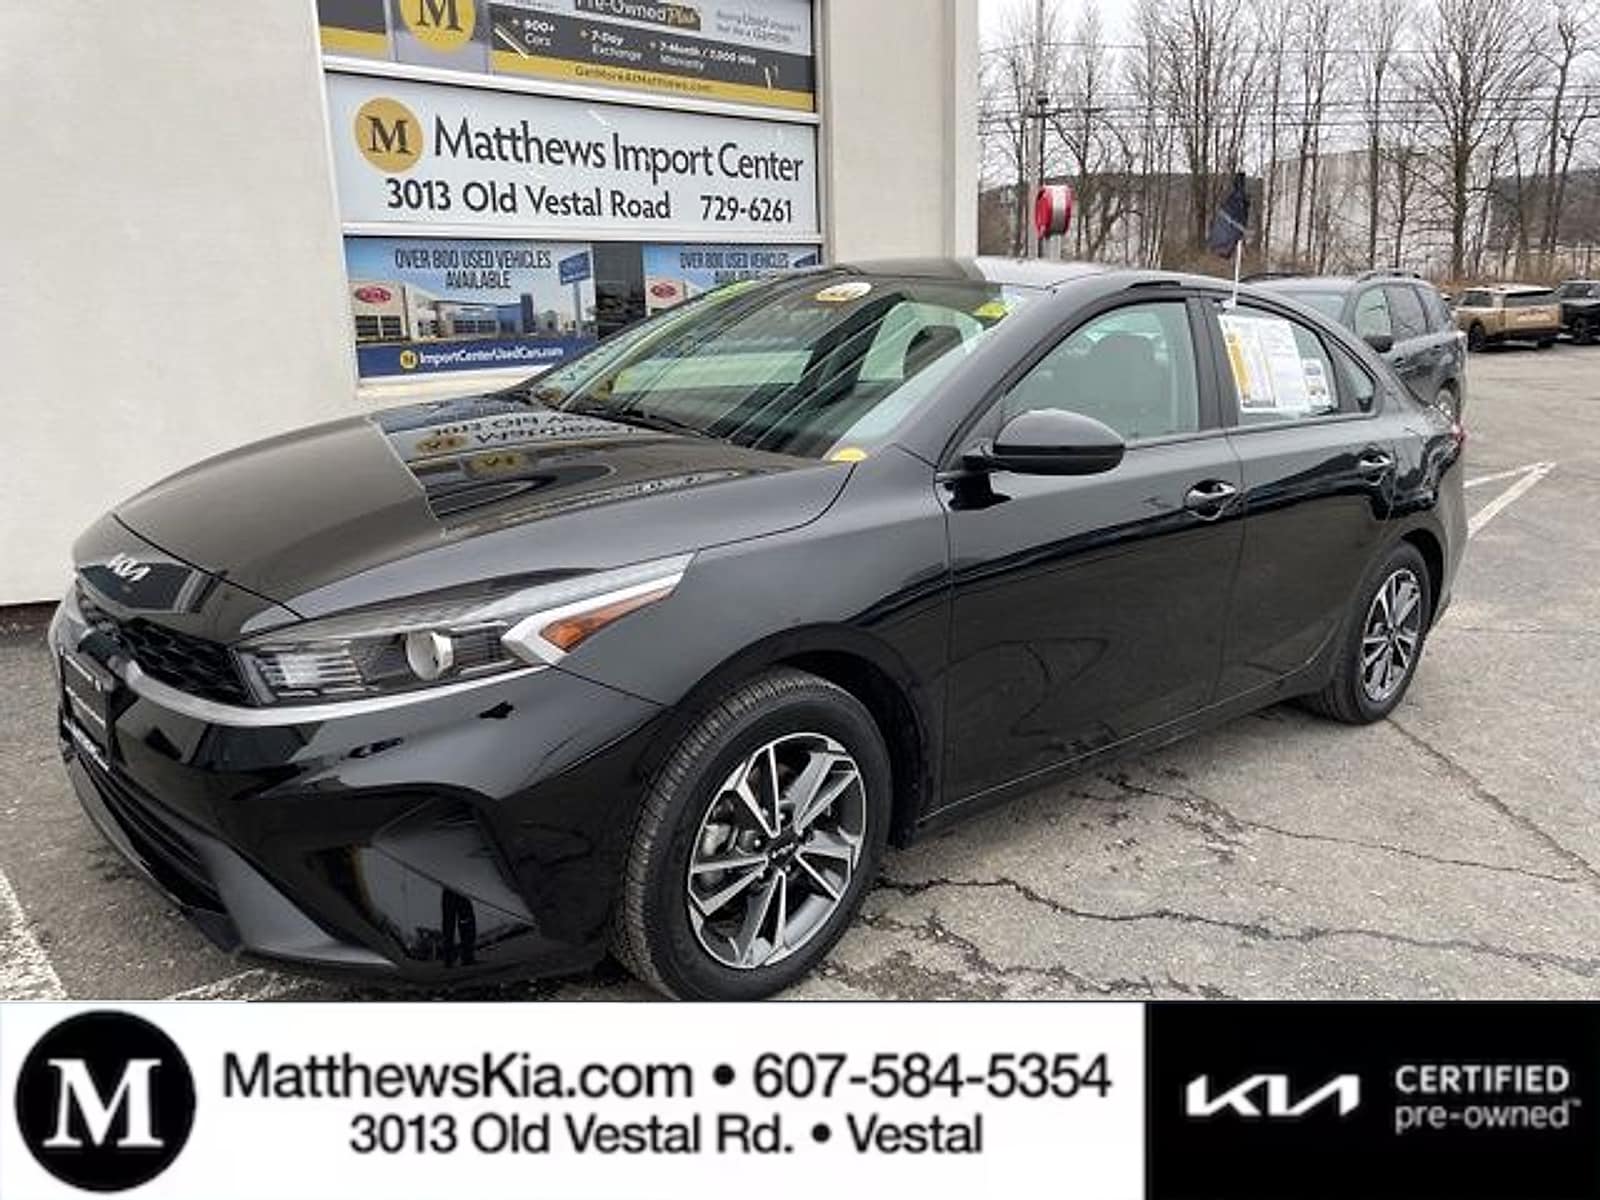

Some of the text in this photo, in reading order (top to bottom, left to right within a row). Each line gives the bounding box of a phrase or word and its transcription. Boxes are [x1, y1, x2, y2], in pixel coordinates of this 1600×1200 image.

[415, 0, 463, 32] M
[367, 115, 413, 156] M
[434, 115, 804, 185] Matthews Import Center
[386, 177, 793, 224] 3013 Old Vestal Road 729-6261
[395, 249, 431, 269] OVER
[433, 249, 460, 269] 800
[463, 249, 493, 269] USED
[496, 249, 552, 270] VEHICLES
[445, 270, 512, 289] AVAILABLE
[420, 346, 565, 368] ImportCenterUsedCars.com
